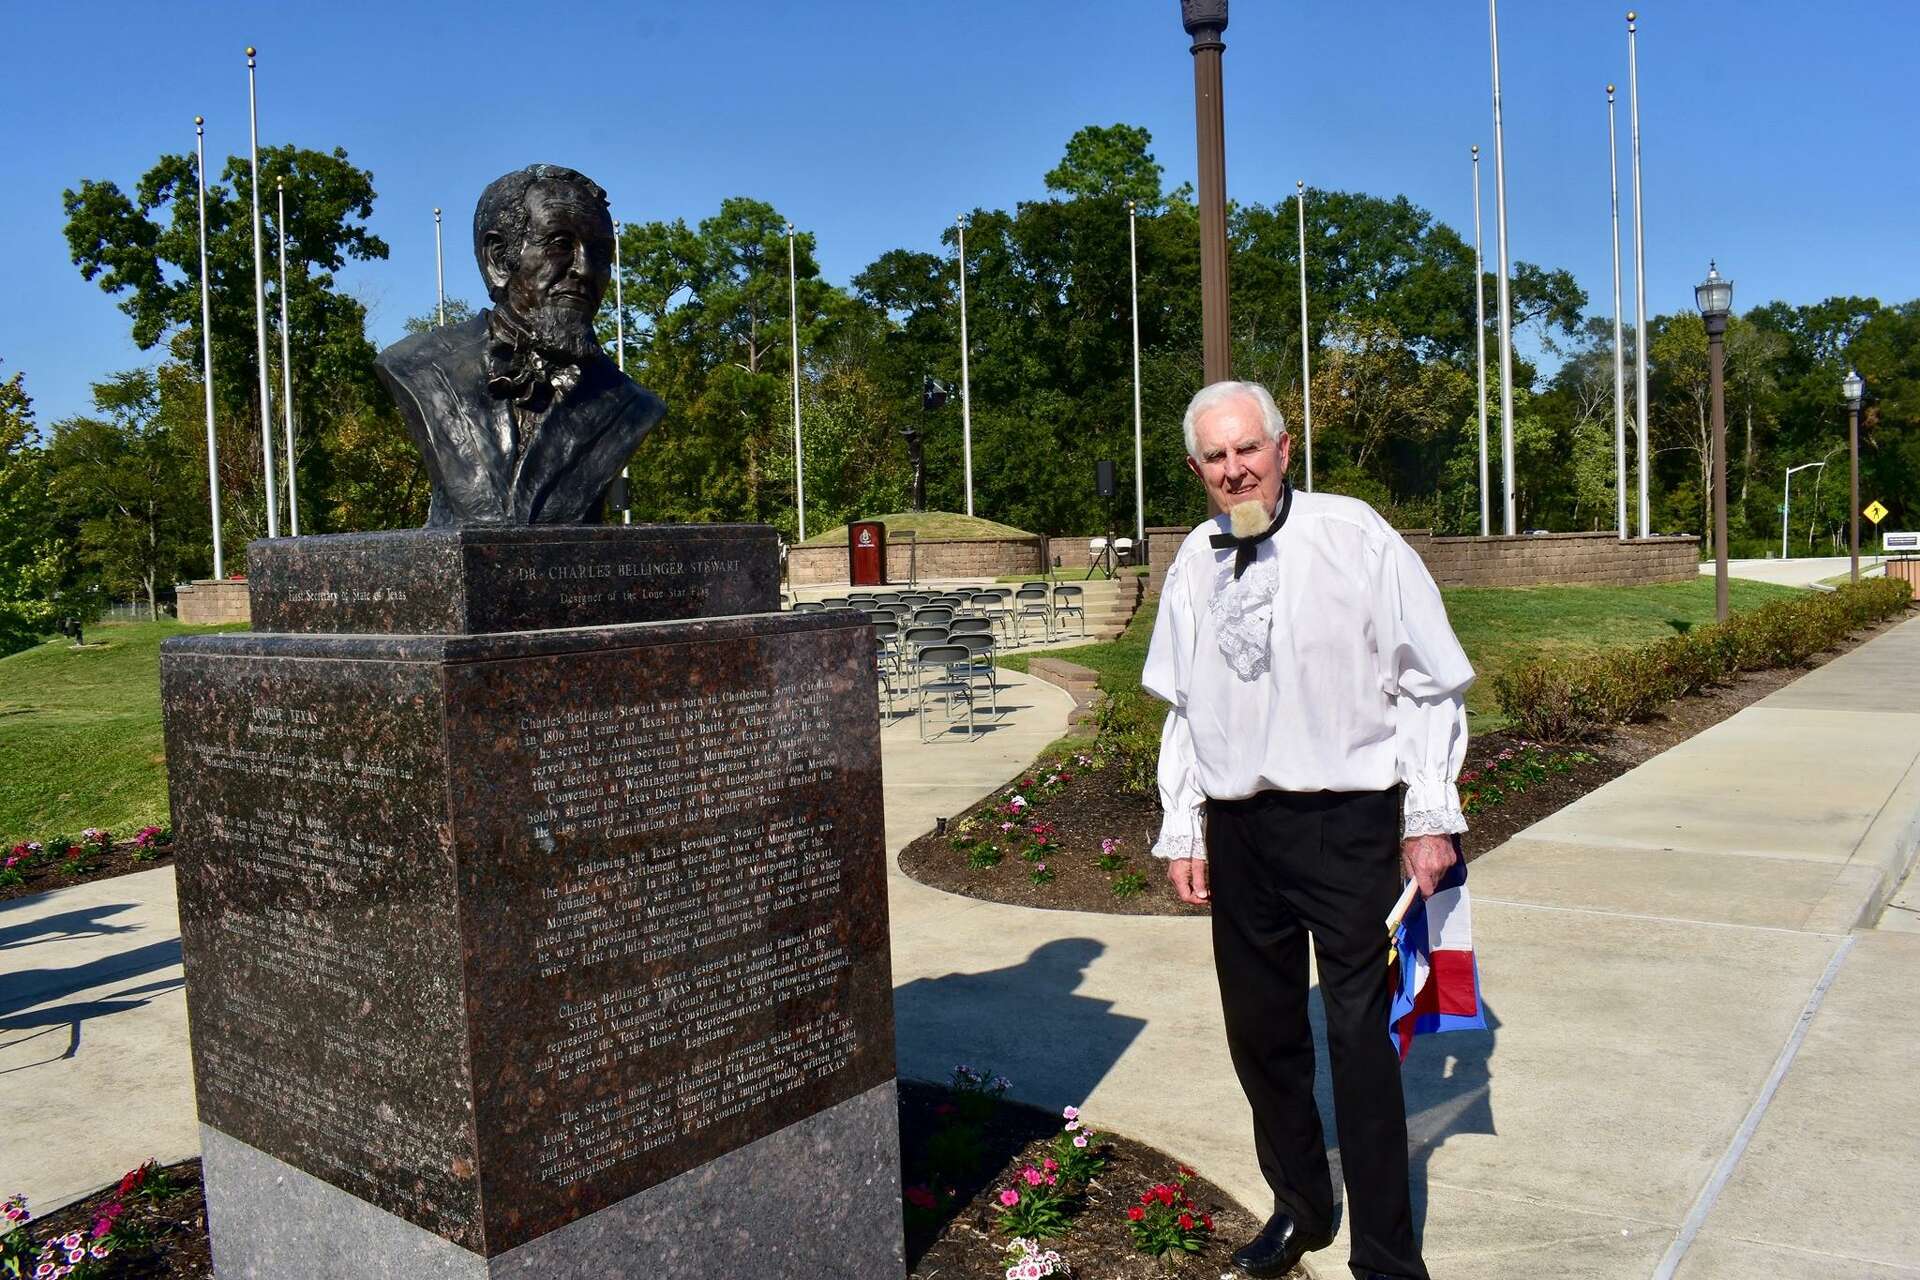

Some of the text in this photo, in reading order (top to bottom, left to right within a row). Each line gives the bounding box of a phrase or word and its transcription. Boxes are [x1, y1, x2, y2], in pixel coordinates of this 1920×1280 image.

[305, 589, 338, 605] Secretary
[353, 588, 370, 601] State
[386, 587, 407, 601] Texas
[549, 565, 612, 580] CHARLES
[618, 562, 685, 577] BELLINGER
[690, 559, 741, 574] STEWART
[560, 592, 601, 605] Designer
[642, 588, 664, 600] Lone
[520, 714, 561, 730] Charles
[567, 707, 612, 726] Bellinger
[619, 702, 654, 717] Stewart
[682, 695, 703, 708] born
[558, 740, 590, 756] served
[699, 720, 725, 734] Battle
[640, 715, 665, 729] Texas
[736, 700, 767, 714] member
[530, 728, 762, 776] served first Secretary State Texas
[533, 742, 757, 791] then elected delegate from Municipality
[526, 766, 781, 826] boldly signed Texas Declaration Independence
[547, 783, 604, 804] Convention
[582, 772, 816, 828] served member committee drafted
[604, 801, 740, 839] Constitution Republic
[564, 825, 814, 894] Lake Creek Settlement where town Montgomery
[577, 854, 624, 878] Following
[650, 843, 675, 858] Texas
[733, 822, 764, 839] Stewart
[769, 816, 794, 831] moved
[535, 856, 840, 948] lived worked Montgomery adult where
[546, 846, 831, 932] Montgomery County town Stewart
[556, 851, 759, 911] founded helped locate
[591, 870, 840, 950] physician successful business Stewart married
[540, 960, 567, 978] twice
[581, 949, 603, 966] first
[716, 907, 752, 929] following
[811, 882, 840, 900] married
[642, 940, 686, 963] Elizabeth
[692, 925, 738, 948] Antoinette
[546, 945, 842, 1055] represented Montgomery County Constitutional Convention
[558, 923, 832, 1019] Charles Bellinger Stewart designed the world famous LONE
[567, 953, 777, 1031] STAR FLAG OF TEXAS which adopted
[559, 969, 809, 1066] signed Texas State Constitution Following
[575, 972, 837, 1074] served House Representatives Texas State
[542, 1028, 822, 1147] Lone Star Monument Historical Flag Stewart died
[560, 1028, 791, 1125] The Stewart home located seventeen miles
[579, 1125, 610, 1148] buried
[652, 1101, 670, 1118] New
[676, 1083, 716, 1110] Cemetery
[833, 1028, 856, 1046] ardent
[585, 1051, 829, 1161] Charles Stewart imprint boldly written
[558, 1098, 746, 1187] institutions history country
